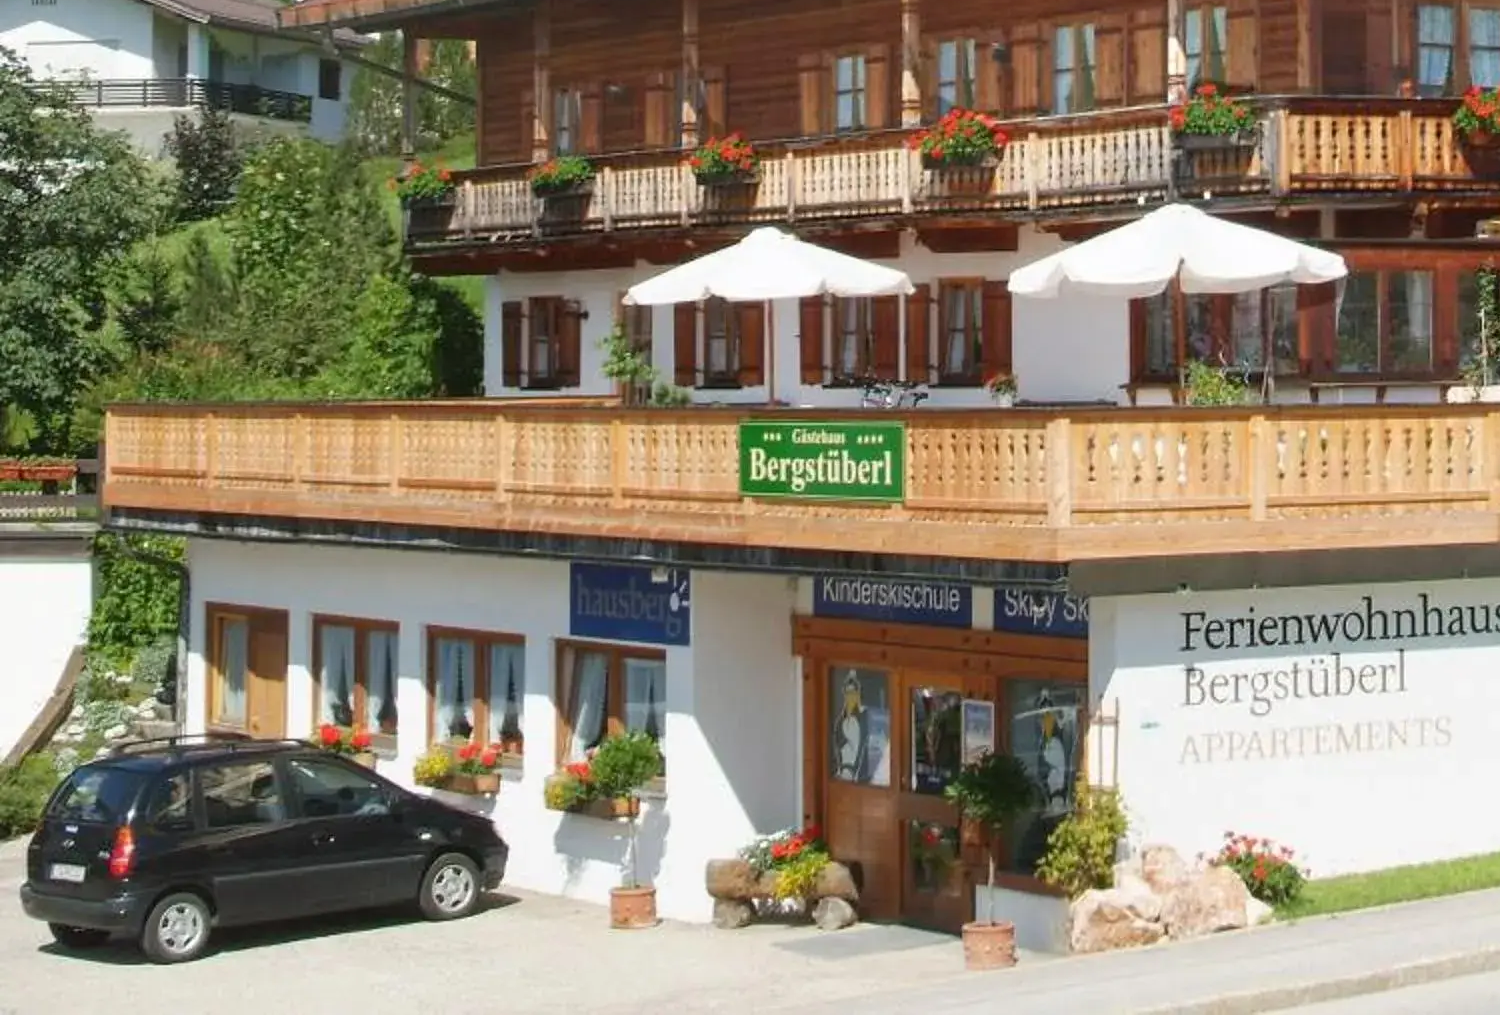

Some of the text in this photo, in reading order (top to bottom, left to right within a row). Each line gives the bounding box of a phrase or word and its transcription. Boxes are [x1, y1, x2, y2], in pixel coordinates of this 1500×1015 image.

[749, 448, 892, 492] Bergstüberl
[575, 573, 683, 637] hausberg
[823, 577, 960, 612] Kinderskischule
[1182, 648, 1408, 717] Bergstüberl
[1178, 715, 1453, 765] APPARTEMENTS
